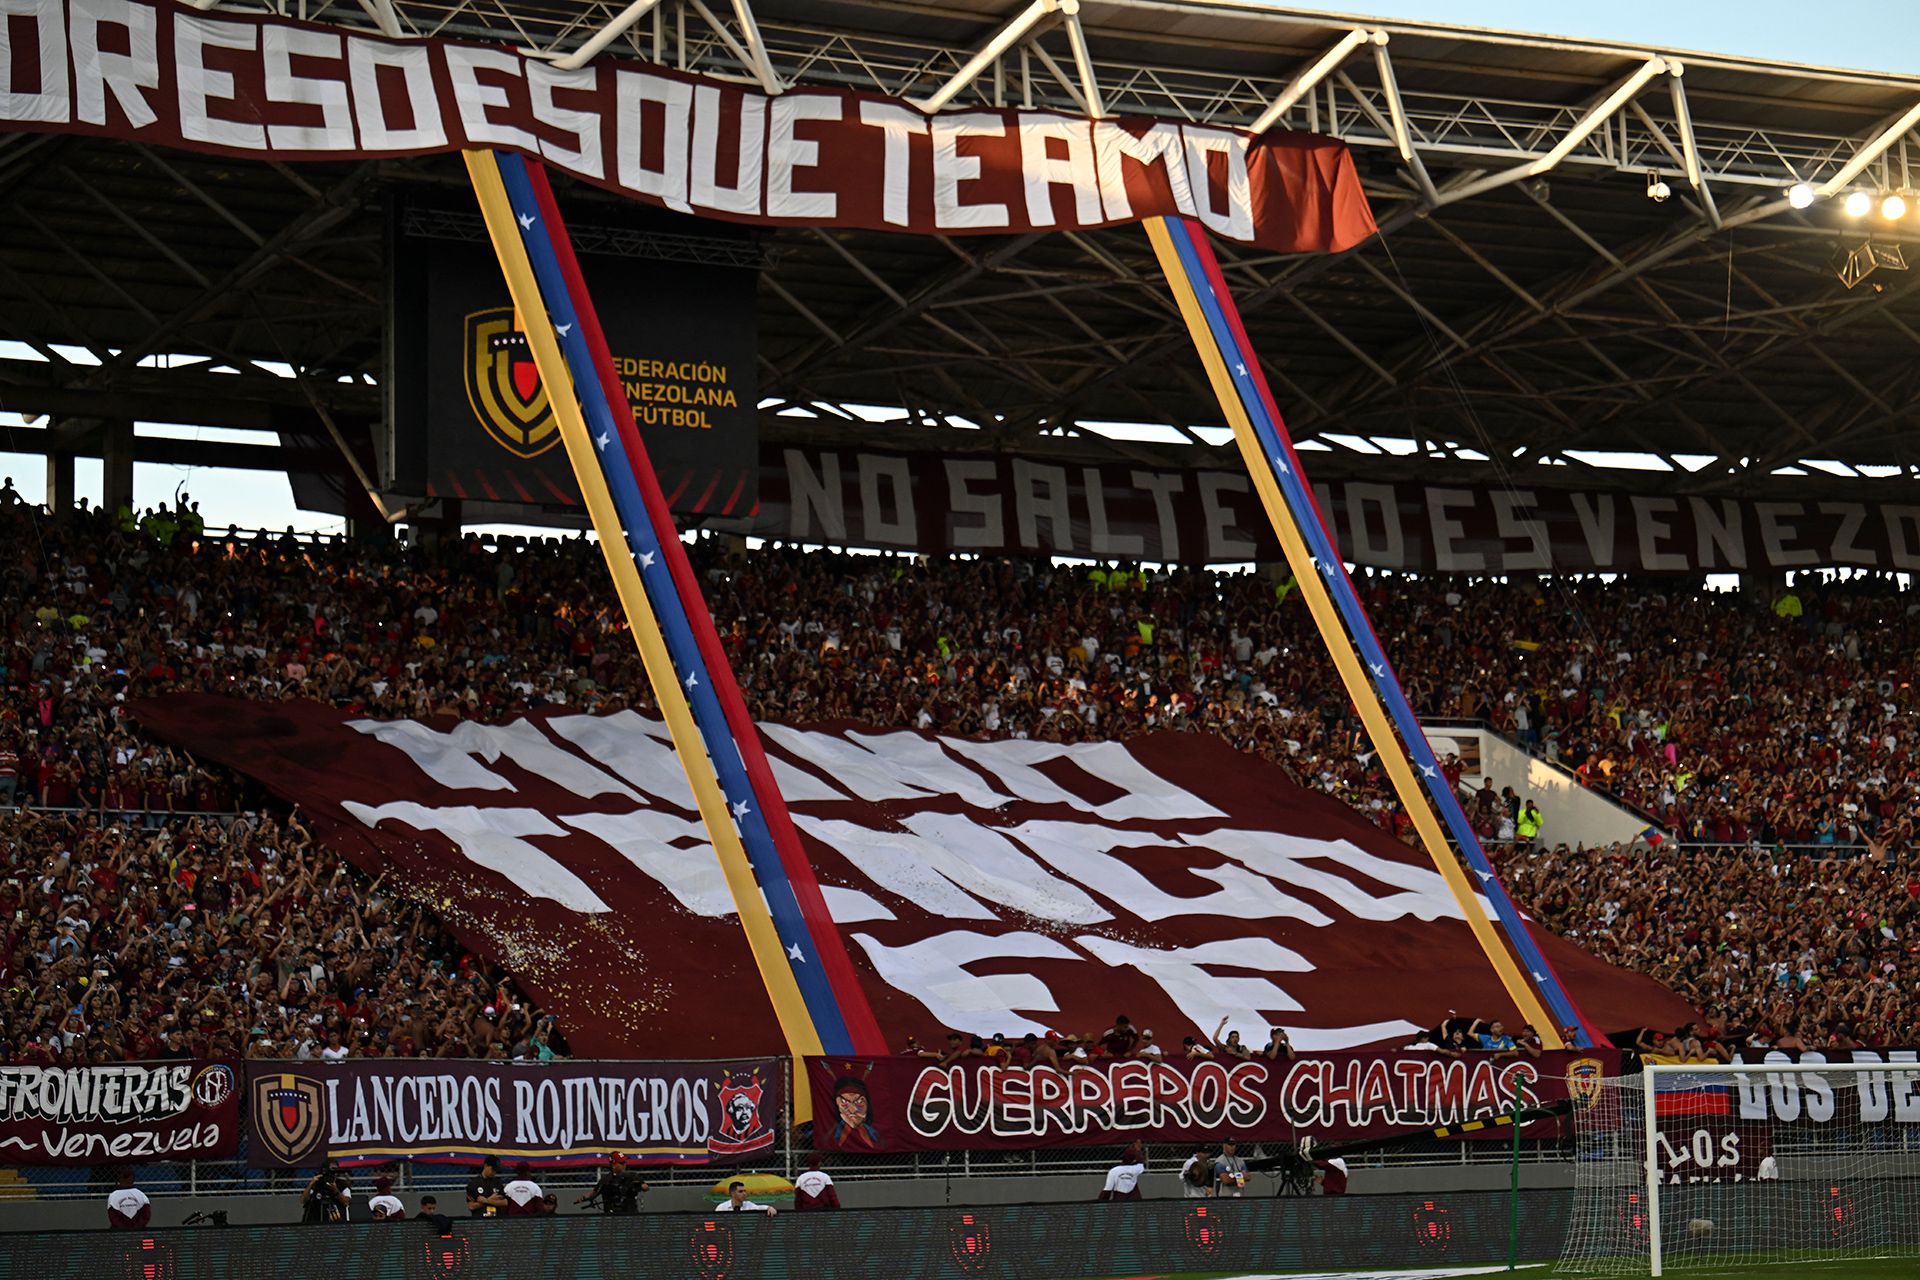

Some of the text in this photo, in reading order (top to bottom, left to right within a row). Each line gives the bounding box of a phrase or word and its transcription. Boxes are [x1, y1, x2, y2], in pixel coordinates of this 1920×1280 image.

[0, 0, 1255, 241] OR ESO ES QUE TE AMO
[611, 357, 726, 384] EDERACIÓN
[621, 381, 738, 408] NEZOLANA
[632, 403, 712, 429] FÚTBOL
[783, 448, 918, 545] NO
[942, 457, 1258, 560] SALTE
[1423, 486, 1551, 571] ES
[1569, 491, 1920, 571] VENEZO
[850, 931, 1431, 1053] FE
[326, 1074, 710, 1150] LANCEROS ROJINEGROS
[906, 1058, 1540, 1138] GUERREROS CHAIMAS
[41, 1122, 220, 1157] Venezuela
[1655, 1129, 1740, 1169] LOS
